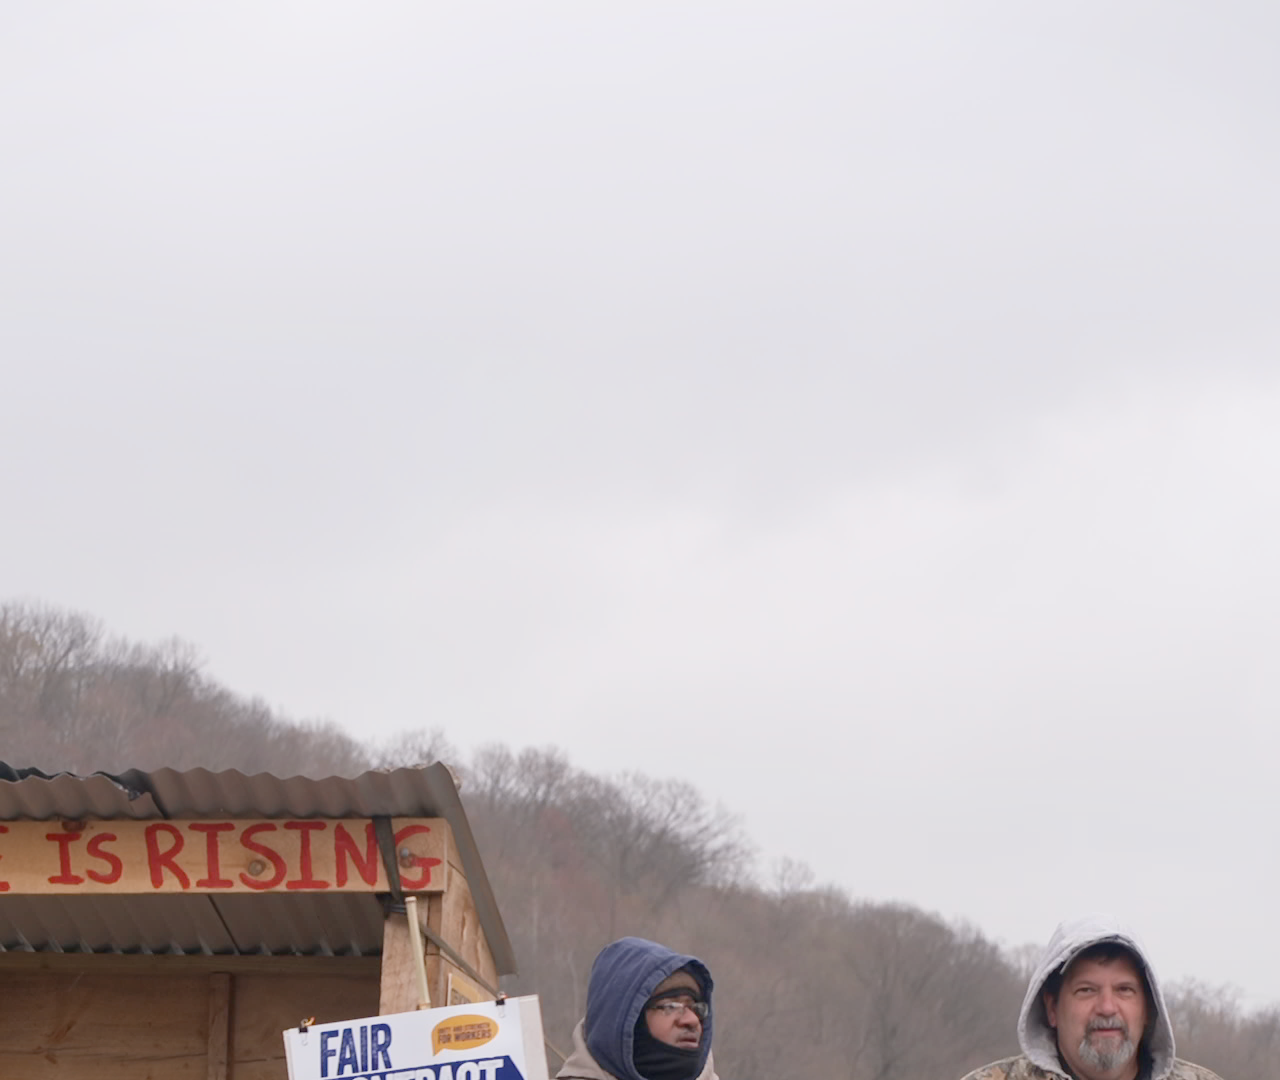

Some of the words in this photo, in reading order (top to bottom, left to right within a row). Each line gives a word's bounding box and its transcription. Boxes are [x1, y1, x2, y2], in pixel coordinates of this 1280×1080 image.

[46, 832, 124, 886] IS
[144, 820, 442, 891] RISING
[320, 1023, 393, 1079] FAIR
